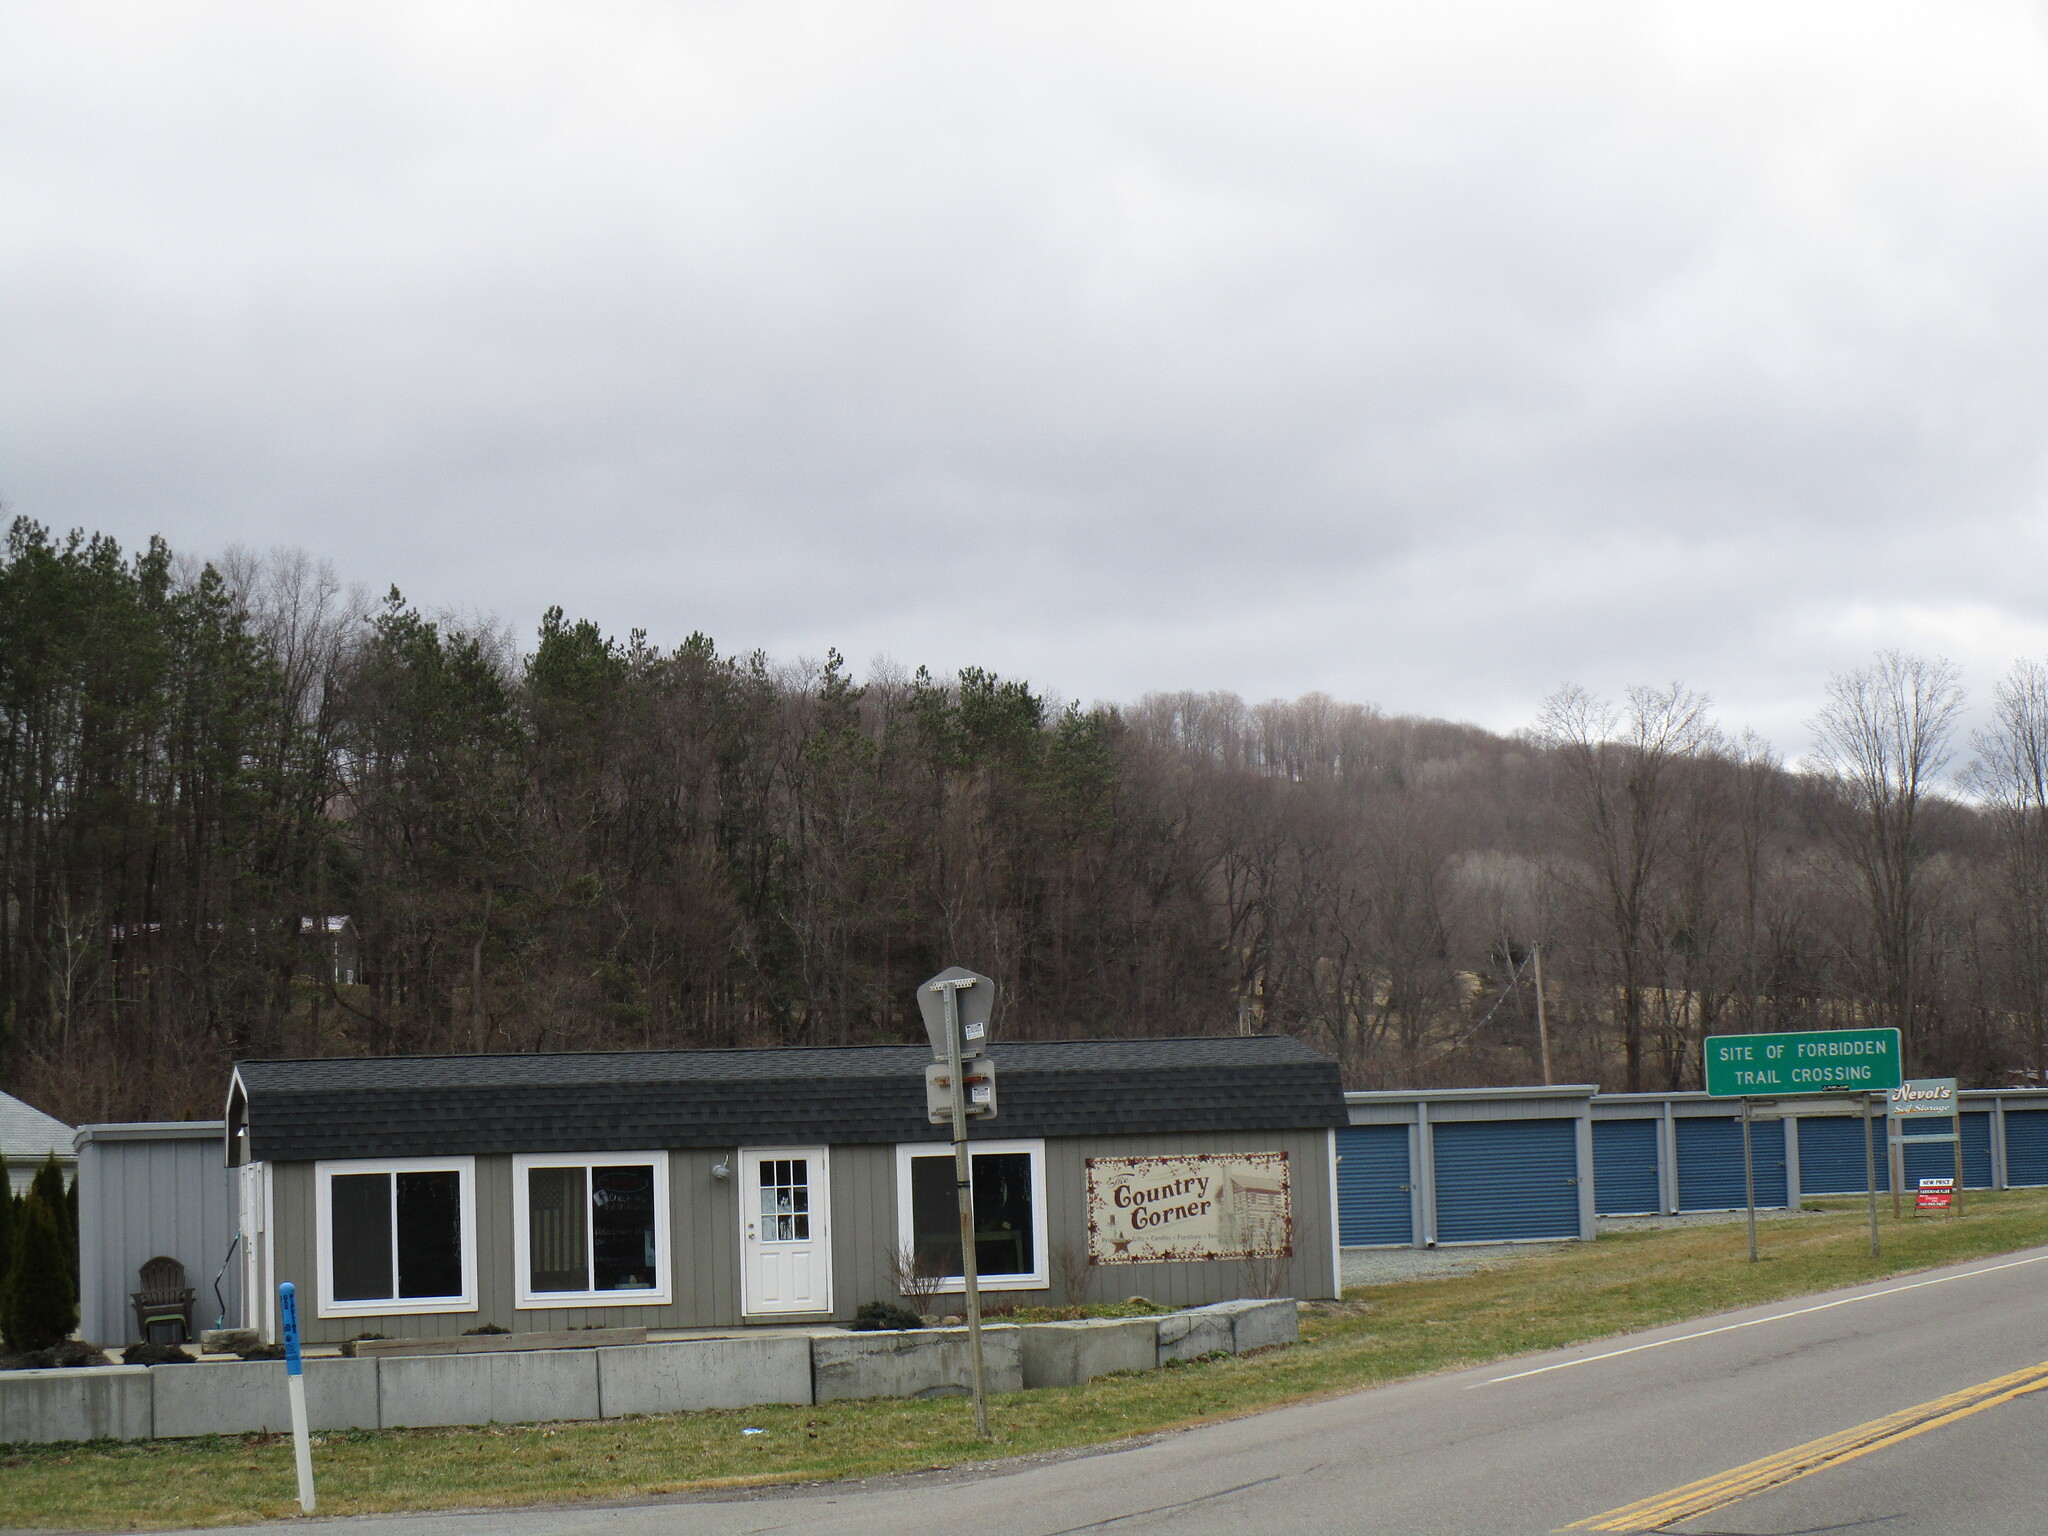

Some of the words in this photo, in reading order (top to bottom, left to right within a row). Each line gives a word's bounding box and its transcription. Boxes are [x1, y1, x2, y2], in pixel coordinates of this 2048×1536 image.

[1720, 1047, 1754, 1061] SITE
[1767, 1045, 1785, 1059] OF
[1798, 1040, 1887, 1058] FORBIDDEN
[1735, 1070, 1781, 1085] TRAIL
[1792, 1065, 1872, 1083] CROSSING
[1892, 1083, 1952, 1102] Nevol's
[1893, 1104, 1912, 1113] Self
[1913, 1104, 1950, 1114] Storage
[1113, 1176, 1210, 1209] Country
[1131, 1200, 1212, 1230] Corner
